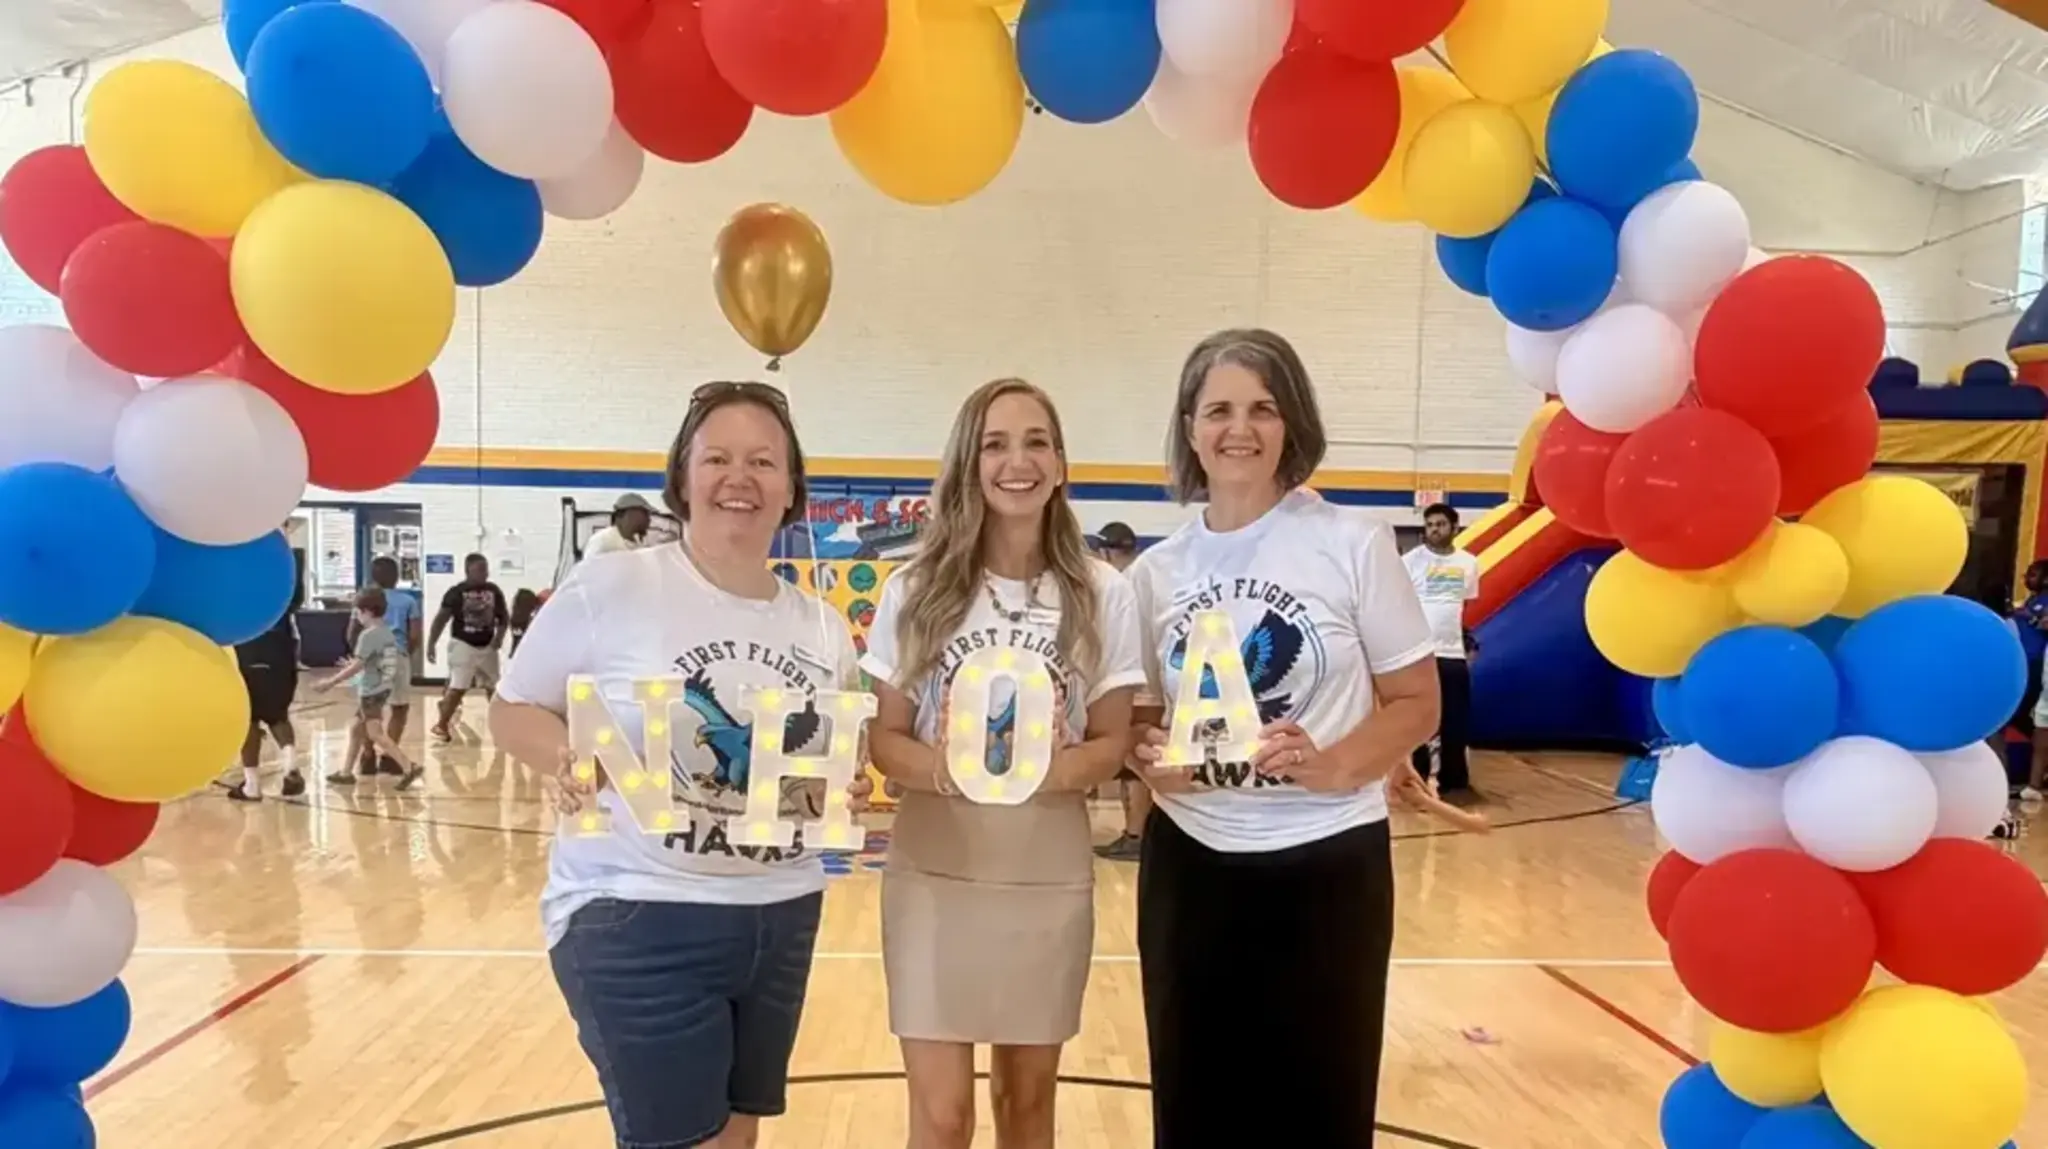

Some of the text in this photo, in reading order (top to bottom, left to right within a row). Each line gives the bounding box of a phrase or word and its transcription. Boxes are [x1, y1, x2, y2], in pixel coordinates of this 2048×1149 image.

[1233, 578, 1307, 619] FLIGHT
[675, 641, 817, 696] FIRST FLIGHT
